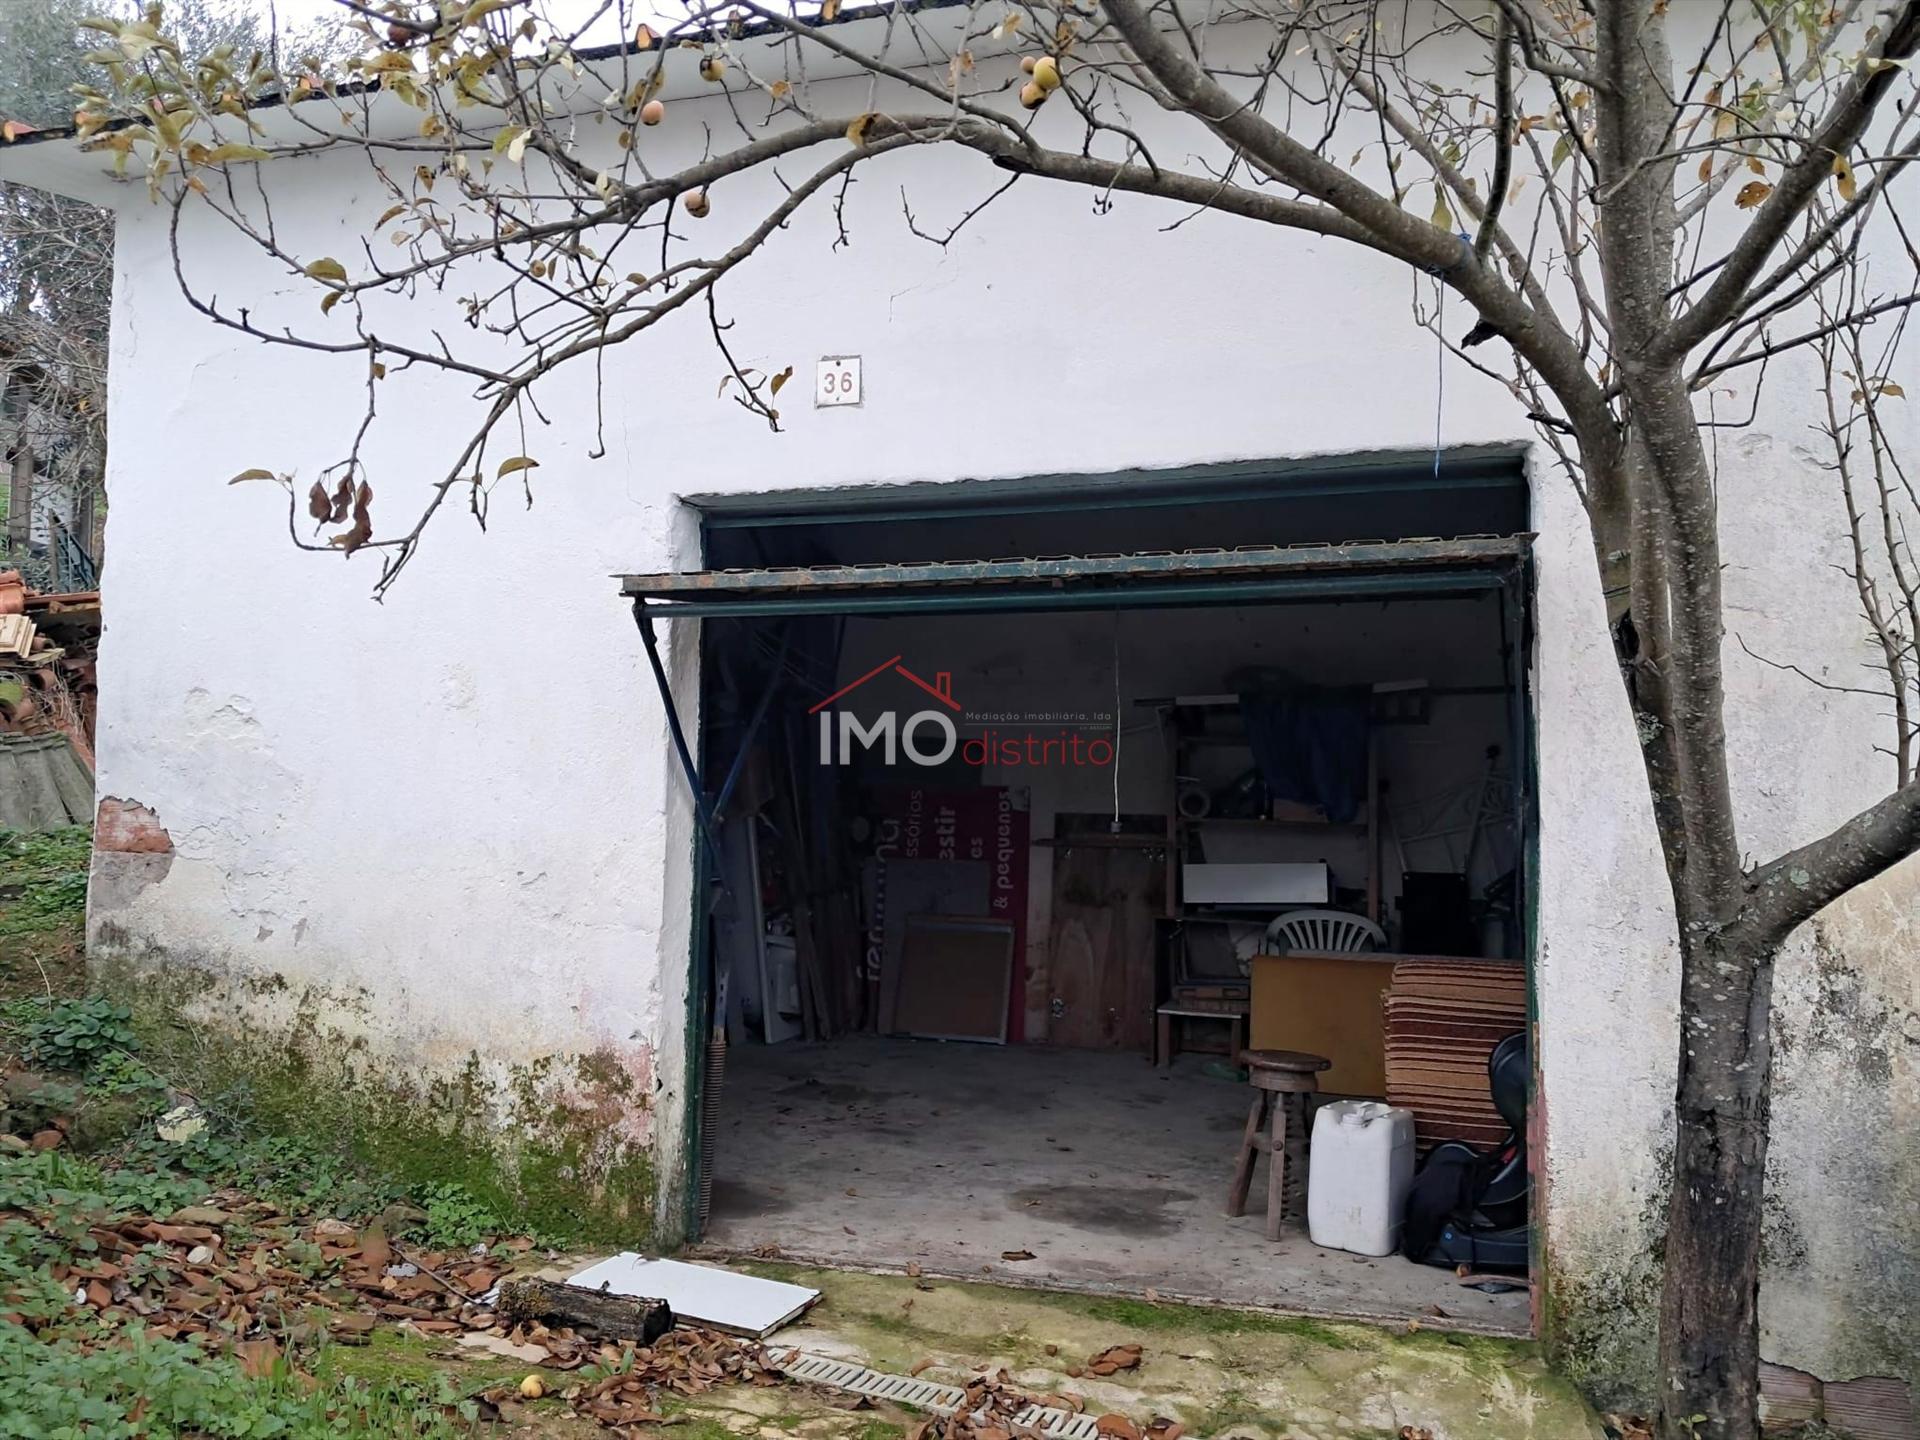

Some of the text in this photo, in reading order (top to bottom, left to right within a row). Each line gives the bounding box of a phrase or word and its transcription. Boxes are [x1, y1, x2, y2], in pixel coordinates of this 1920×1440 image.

[824, 371, 852, 394] 36
[934, 806, 956, 861] estir
[996, 790, 1016, 889] pequenos
